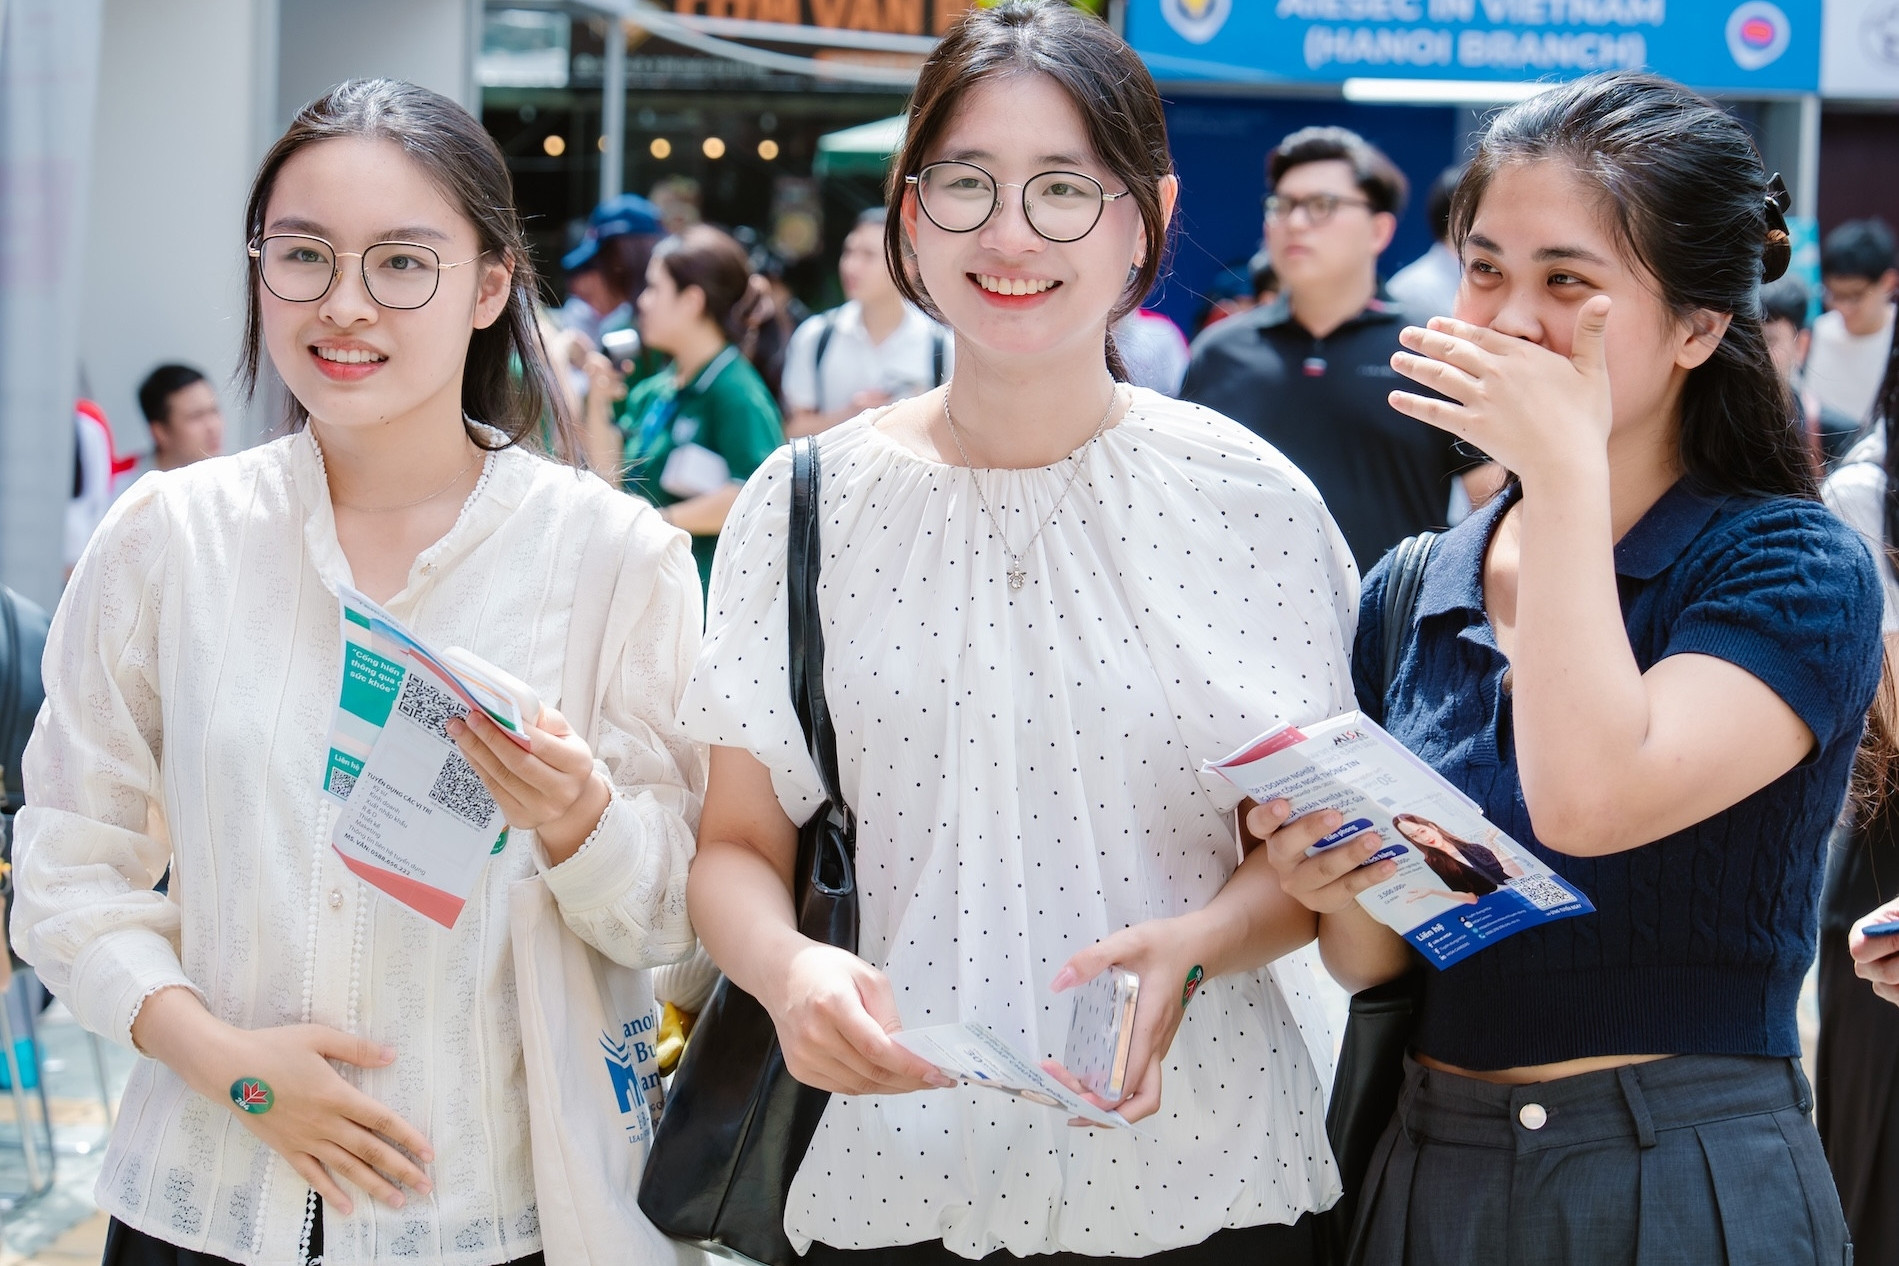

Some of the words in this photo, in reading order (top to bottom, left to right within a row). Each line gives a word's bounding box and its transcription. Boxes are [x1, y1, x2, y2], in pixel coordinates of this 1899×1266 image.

[1428, 0, 1475, 24] IN
[1482, 0, 1666, 26] VIETNAM
[1303, 24, 1452, 70] (HANOI
[1457, 29, 1647, 70] BRANCH)
[350, 658, 377, 675] thông
[377, 672, 395, 685] qua
[350, 669, 367, 681] sức
[1332, 727, 1363, 744] MISA
[333, 754, 350, 765] Liên
[349, 761, 360, 770] hệ
[1265, 774, 1290, 790] DOANH
[1281, 781, 1300, 795] CÔNG
[1346, 758, 1359, 768] TIN
[366, 772, 385, 786] TUYỂN
[385, 784, 403, 797] DỤNG
[403, 794, 416, 805] CÁC
[369, 791, 382, 802] Kinh
[382, 799, 400, 813] doanh
[344, 833, 355, 842] MS.
[347, 825, 366, 839] Thông
[366, 836, 374, 844] tin
[1415, 928, 1434, 941] Liên
[1431, 922, 1444, 933] hệ
[623, 1008, 655, 1038] anoi
[634, 1040, 657, 1063] Bu
